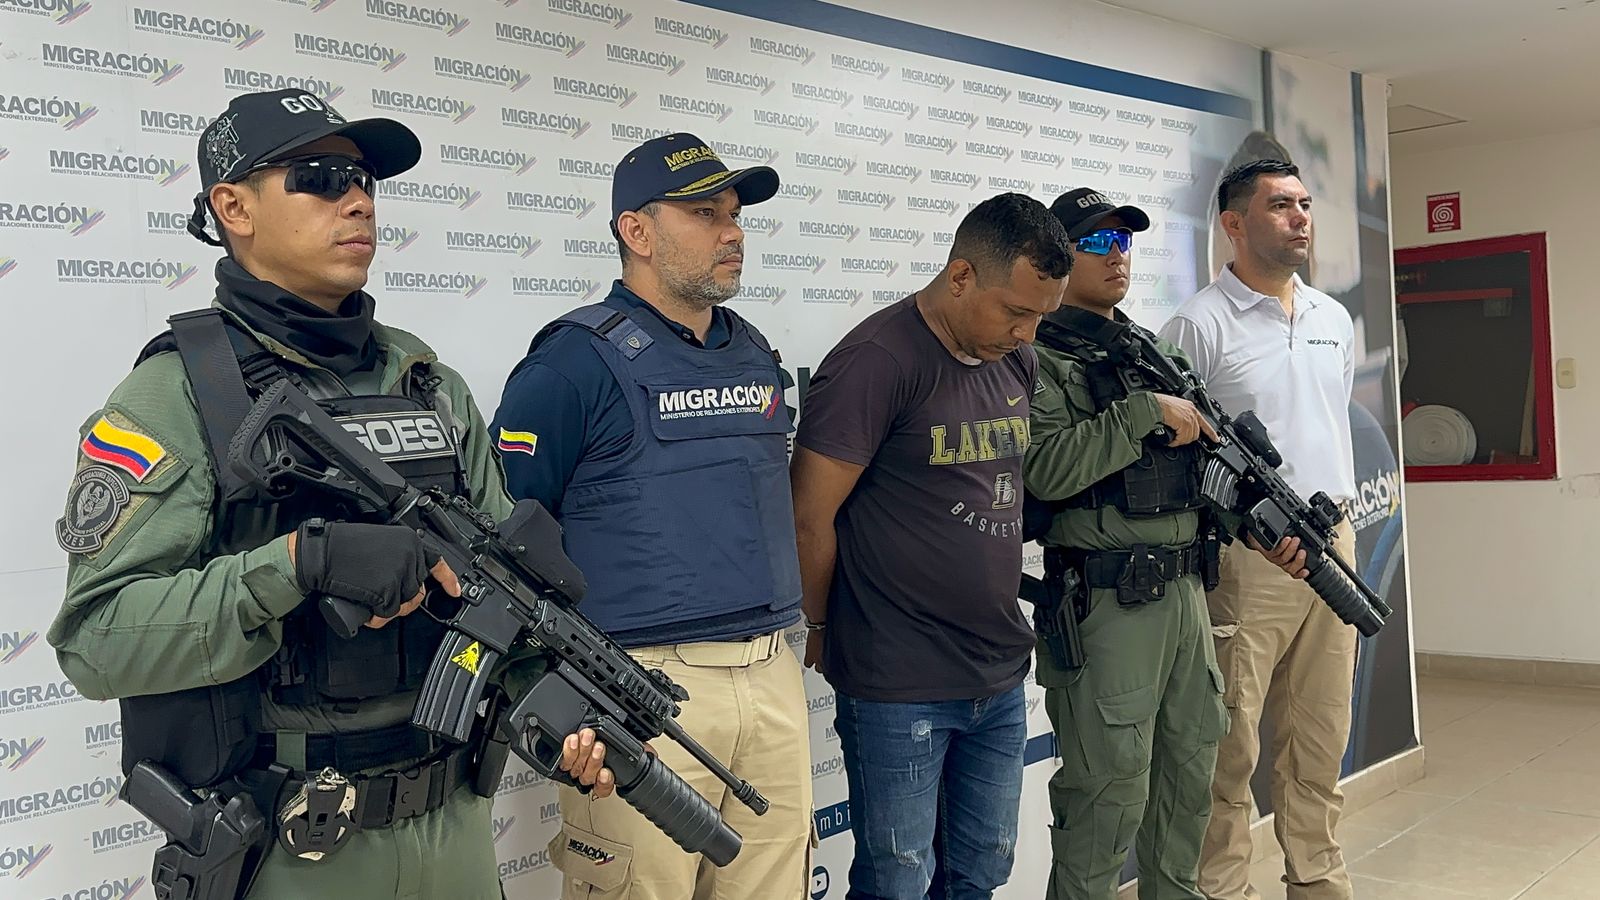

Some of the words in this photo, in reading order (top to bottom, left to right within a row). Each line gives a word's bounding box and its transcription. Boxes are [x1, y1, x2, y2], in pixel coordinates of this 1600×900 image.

[134, 8, 250, 38] MIGRACIÓN
[654, 17, 720, 41] MIGRACIÓN
[496, 22, 575, 49] MIGRACIÓN
[294, 33, 395, 61] MIGRACIÓN
[606, 43, 676, 67] MIGRACIÓN
[750, 37, 808, 58] MIGRACIÓN
[42, 43, 168, 74] MIGRACIÓN
[831, 53, 883, 73] MIGRACIÓN
[434, 57, 520, 82] MIGRACIÓN
[706, 67, 767, 88] MIGRACIÓN
[902, 67, 949, 86] MIGRACIÓN
[224, 68, 331, 96] MIGRACIÓN
[553, 77, 628, 100] MIGRACIÓN
[792, 82, 847, 101] MIGRACIÓN
[963, 80, 1006, 96] MIGRACIÓN
[0, 96, 80, 118] ACIÓN
[281, 94, 323, 114] GO
[371, 88, 464, 114] MIGRACIÓN
[659, 94, 725, 115] MIGRACIÓN
[863, 95, 913, 113] MIGRACIÓN
[140, 110, 212, 132] MIGRA
[501, 107, 580, 130] MIGRACIÓN
[754, 109, 812, 128] MIGRACIÓN
[928, 106, 973, 122] MIGRACIÓN
[986, 116, 1027, 131] MIGRACIÓN
[611, 123, 675, 140] MIGRACI
[835, 121, 886, 139] MIGRACIÓN
[905, 132, 952, 148] MIGRACIÓN
[966, 142, 1008, 156] MIGRACIÓN
[50, 150, 175, 175] MIGRACIÓN
[440, 144, 526, 167] MIGRACIÓN
[664, 146, 713, 168] MIGRA
[796, 152, 850, 169] MIGRACIÓN
[559, 158, 614, 176] MIGRACI
[867, 161, 916, 177] MIGRACIÓN
[931, 169, 975, 184] MIGRACIÓN
[379, 180, 470, 201] MIGRACIÓN
[779, 183, 816, 197] RACIÓN
[989, 176, 1030, 189] MIGRACIÓN
[507, 192, 586, 211] MIGRACIÓN
[838, 189, 889, 204] MIGRACIÓN
[908, 196, 954, 210] MIGRACIÓN
[0, 202, 88, 225] RACIÓN
[0, 221, 31, 229] ELACIONES
[800, 221, 853, 236] MIGRACIÓN
[869, 227, 919, 240] MIGRACIÓN
[446, 231, 531, 250] MIGRACIÓN
[57, 258, 182, 279] MIGRACIÓN
[762, 253, 819, 267] MIGRACIÓN
[841, 257, 892, 271] MIGRACIÓN
[911, 262, 946, 272] MIGRAC
[384, 271, 475, 289] MIGRACIÓN
[512, 277, 591, 293] MIGRACIÓN
[738, 284, 779, 298] RACIÓN
[803, 286, 856, 300] MIGRACIÓN
[659, 381, 771, 412] MIGRACIÓN
[660, 411, 696, 420] MINISTERIO
[704, 407, 736, 417] RELACIONES
[737, 406, 760, 414] EXTERIORES
[929, 416, 1031, 466] LAKER
[1346, 467, 1400, 521] ACIÓN
[951, 501, 1023, 538] BASKET
[61, 528, 85, 547] GOES
[0, 681, 80, 708] IGRAC
[811, 755, 844, 776] RACIÓN
[92, 820, 162, 849] MIGRA
[568, 838, 608, 862] MIGRACIÓN
